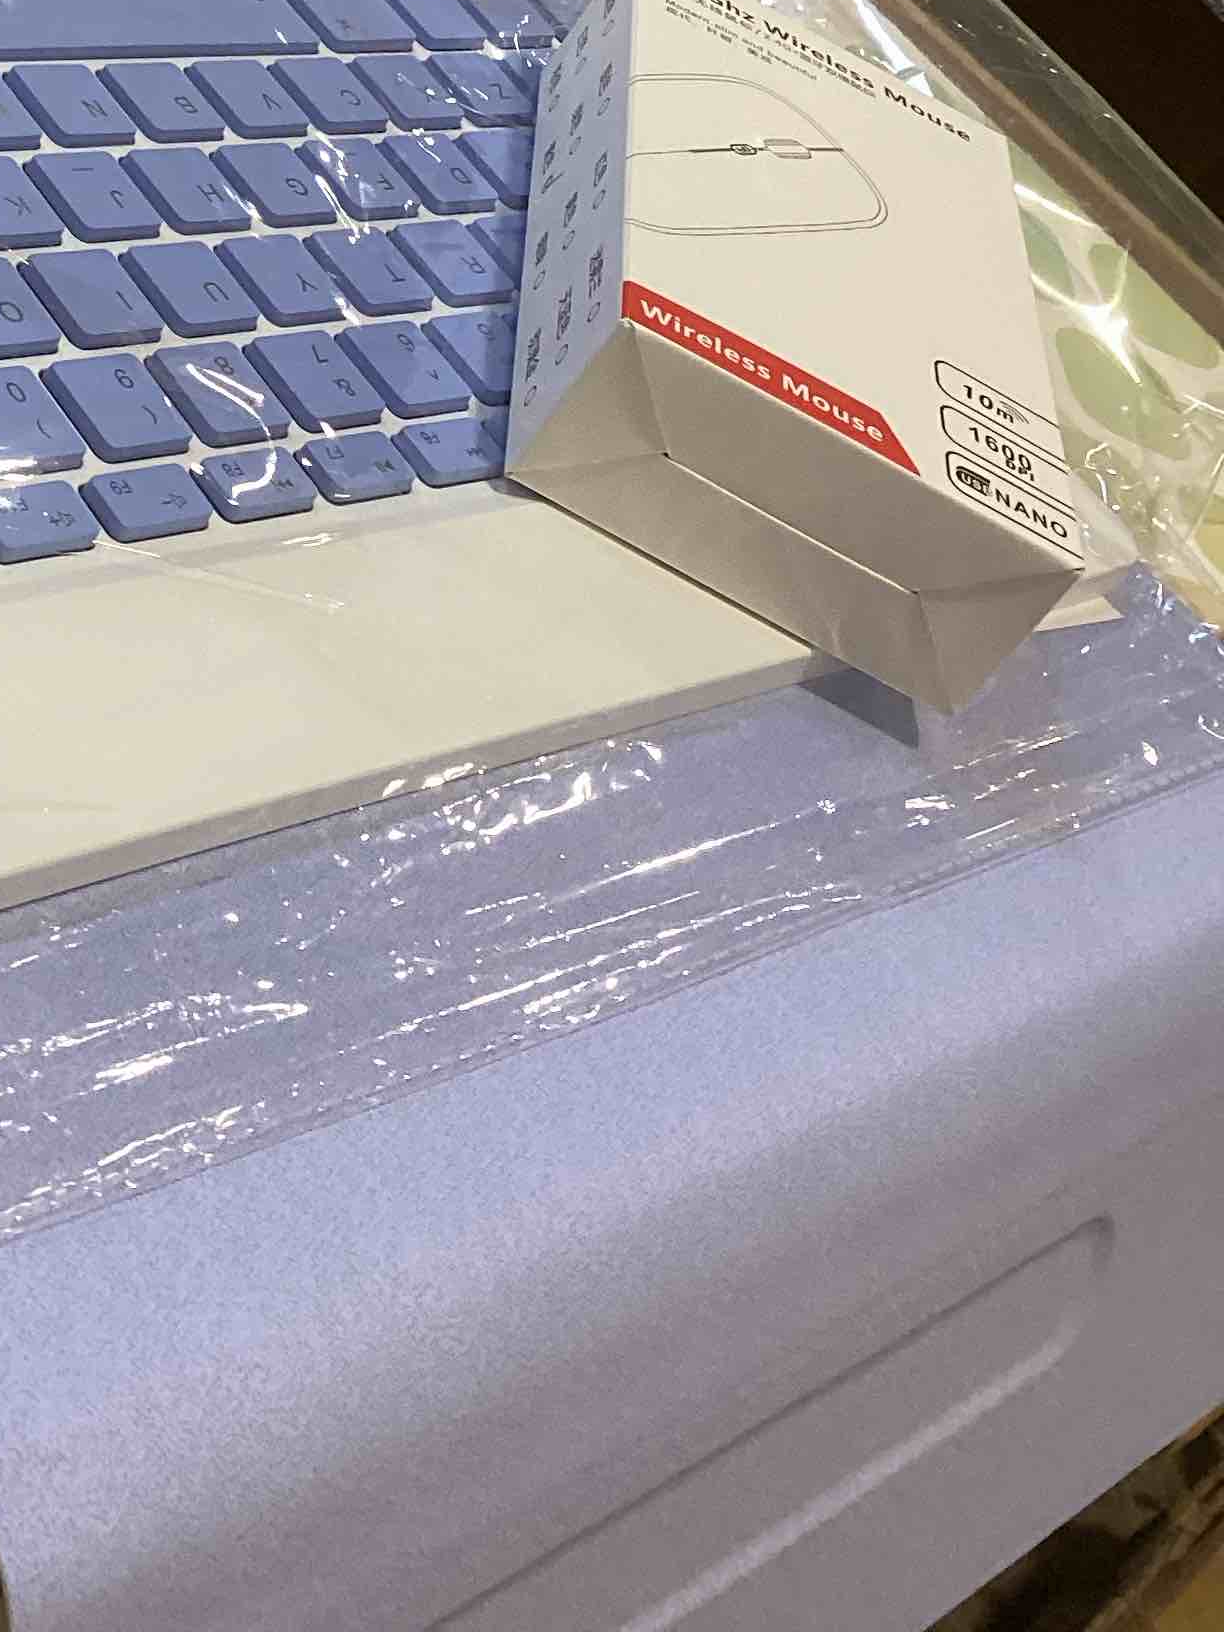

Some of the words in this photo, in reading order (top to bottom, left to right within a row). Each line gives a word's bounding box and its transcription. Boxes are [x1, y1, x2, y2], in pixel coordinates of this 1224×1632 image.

[762, 18, 875, 89] Wireless
[883, 85, 971, 143] Mouse
[639, 298, 772, 381] Wireless
[780, 372, 885, 443] Mouse
[962, 383, 1015, 425] 10m
[968, 426, 1033, 473] 1600
[994, 487, 1069, 539] NANO
